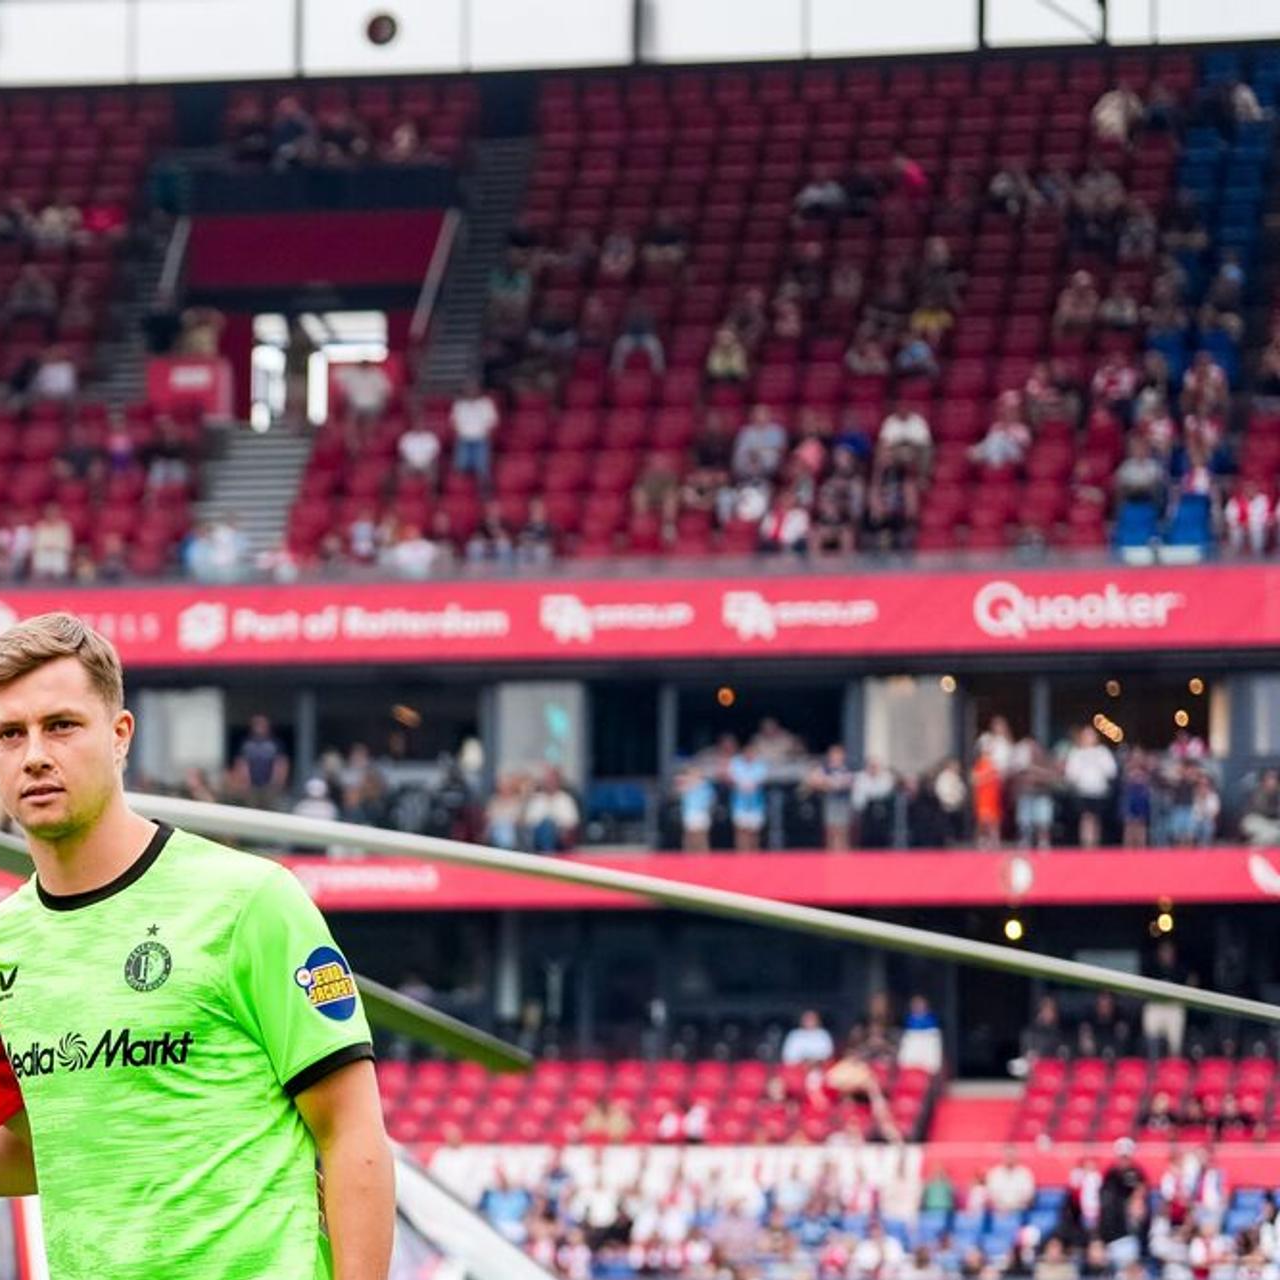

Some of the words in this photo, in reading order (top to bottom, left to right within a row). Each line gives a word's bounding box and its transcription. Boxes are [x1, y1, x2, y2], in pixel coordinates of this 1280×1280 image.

[232, 608, 299, 639] Port
[344, 605, 510, 639] Rotterdam
[974, 581, 1178, 638] Quooker
[7, 1042, 55, 1078] edia
[88, 1028, 194, 1069] Markt
